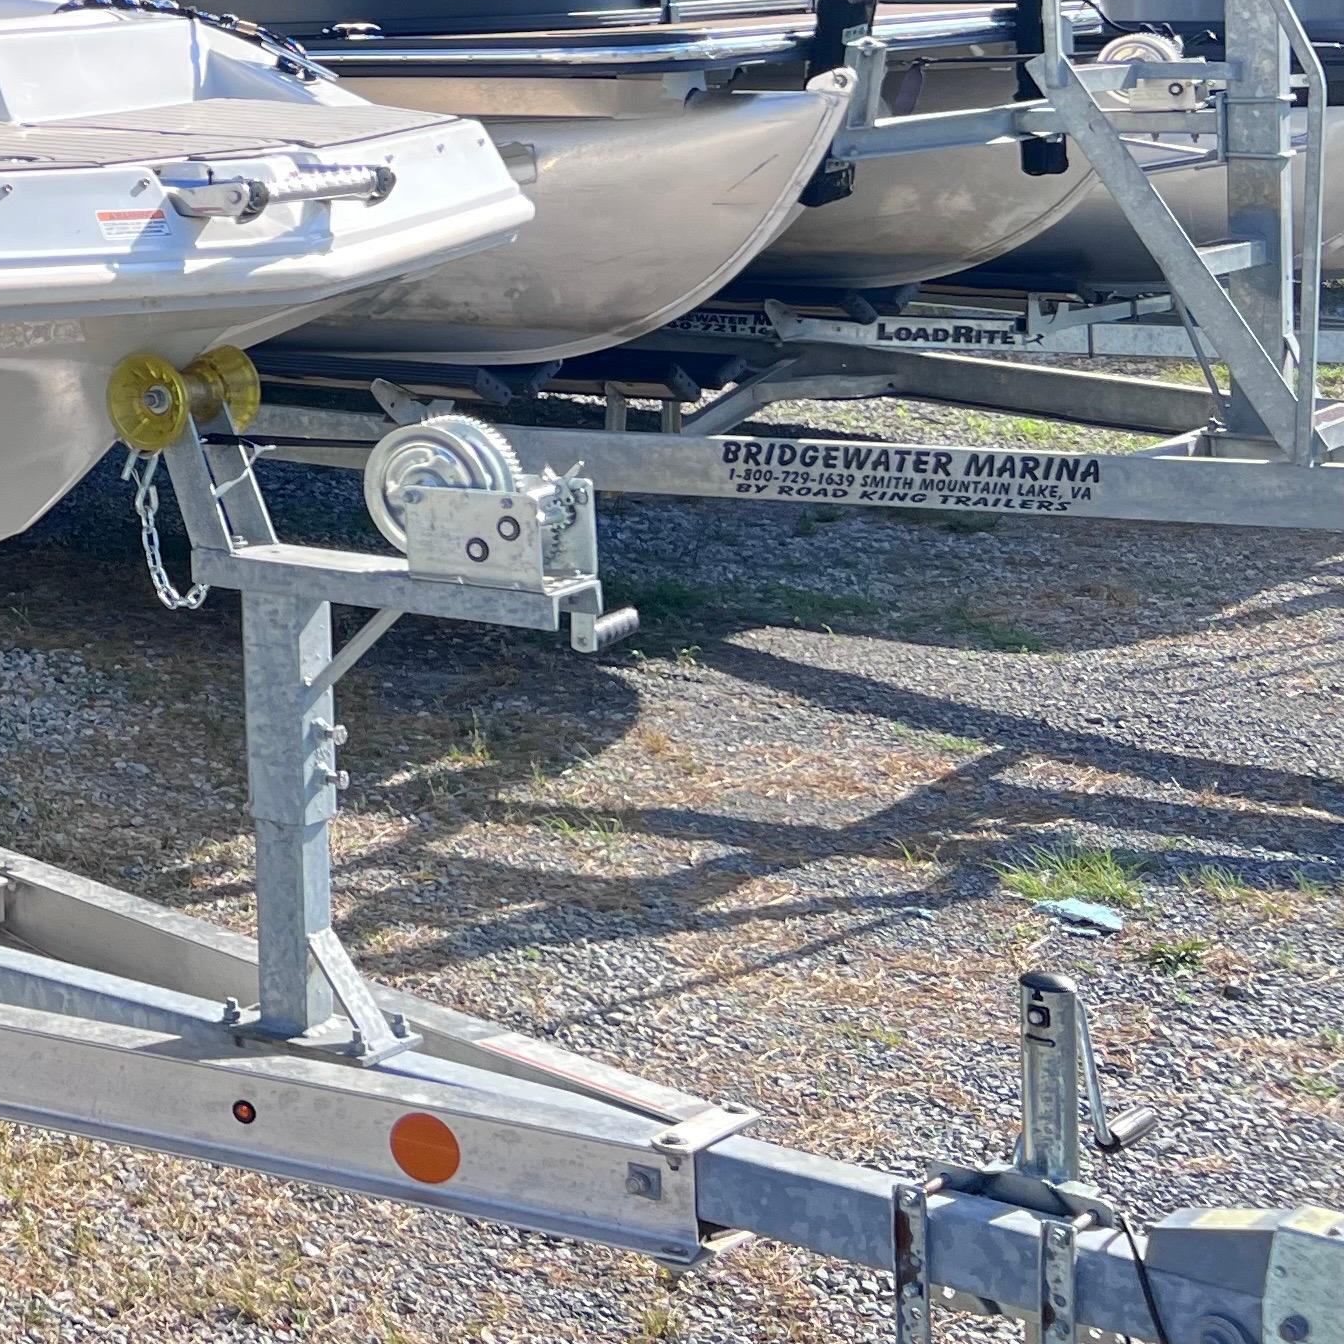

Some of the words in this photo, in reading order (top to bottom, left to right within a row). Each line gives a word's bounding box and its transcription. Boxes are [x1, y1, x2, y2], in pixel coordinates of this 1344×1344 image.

[722, 440, 952, 477] BRIDGEWATER
[963, 453, 1100, 484] MARINA
[728, 467, 855, 487] 1-800-729-1639
[859, 474, 914, 491] SMITH
[918, 477, 1011, 496] MOUNTAIN
[1016, 482, 1063, 501] LAKE,
[1070, 486, 1092, 501] VA
[736, 483, 769, 494] BY
[777, 485, 849, 499] ROAD
[859, 490, 928, 504] KING
[938, 494, 1072, 512] TRAILERS
